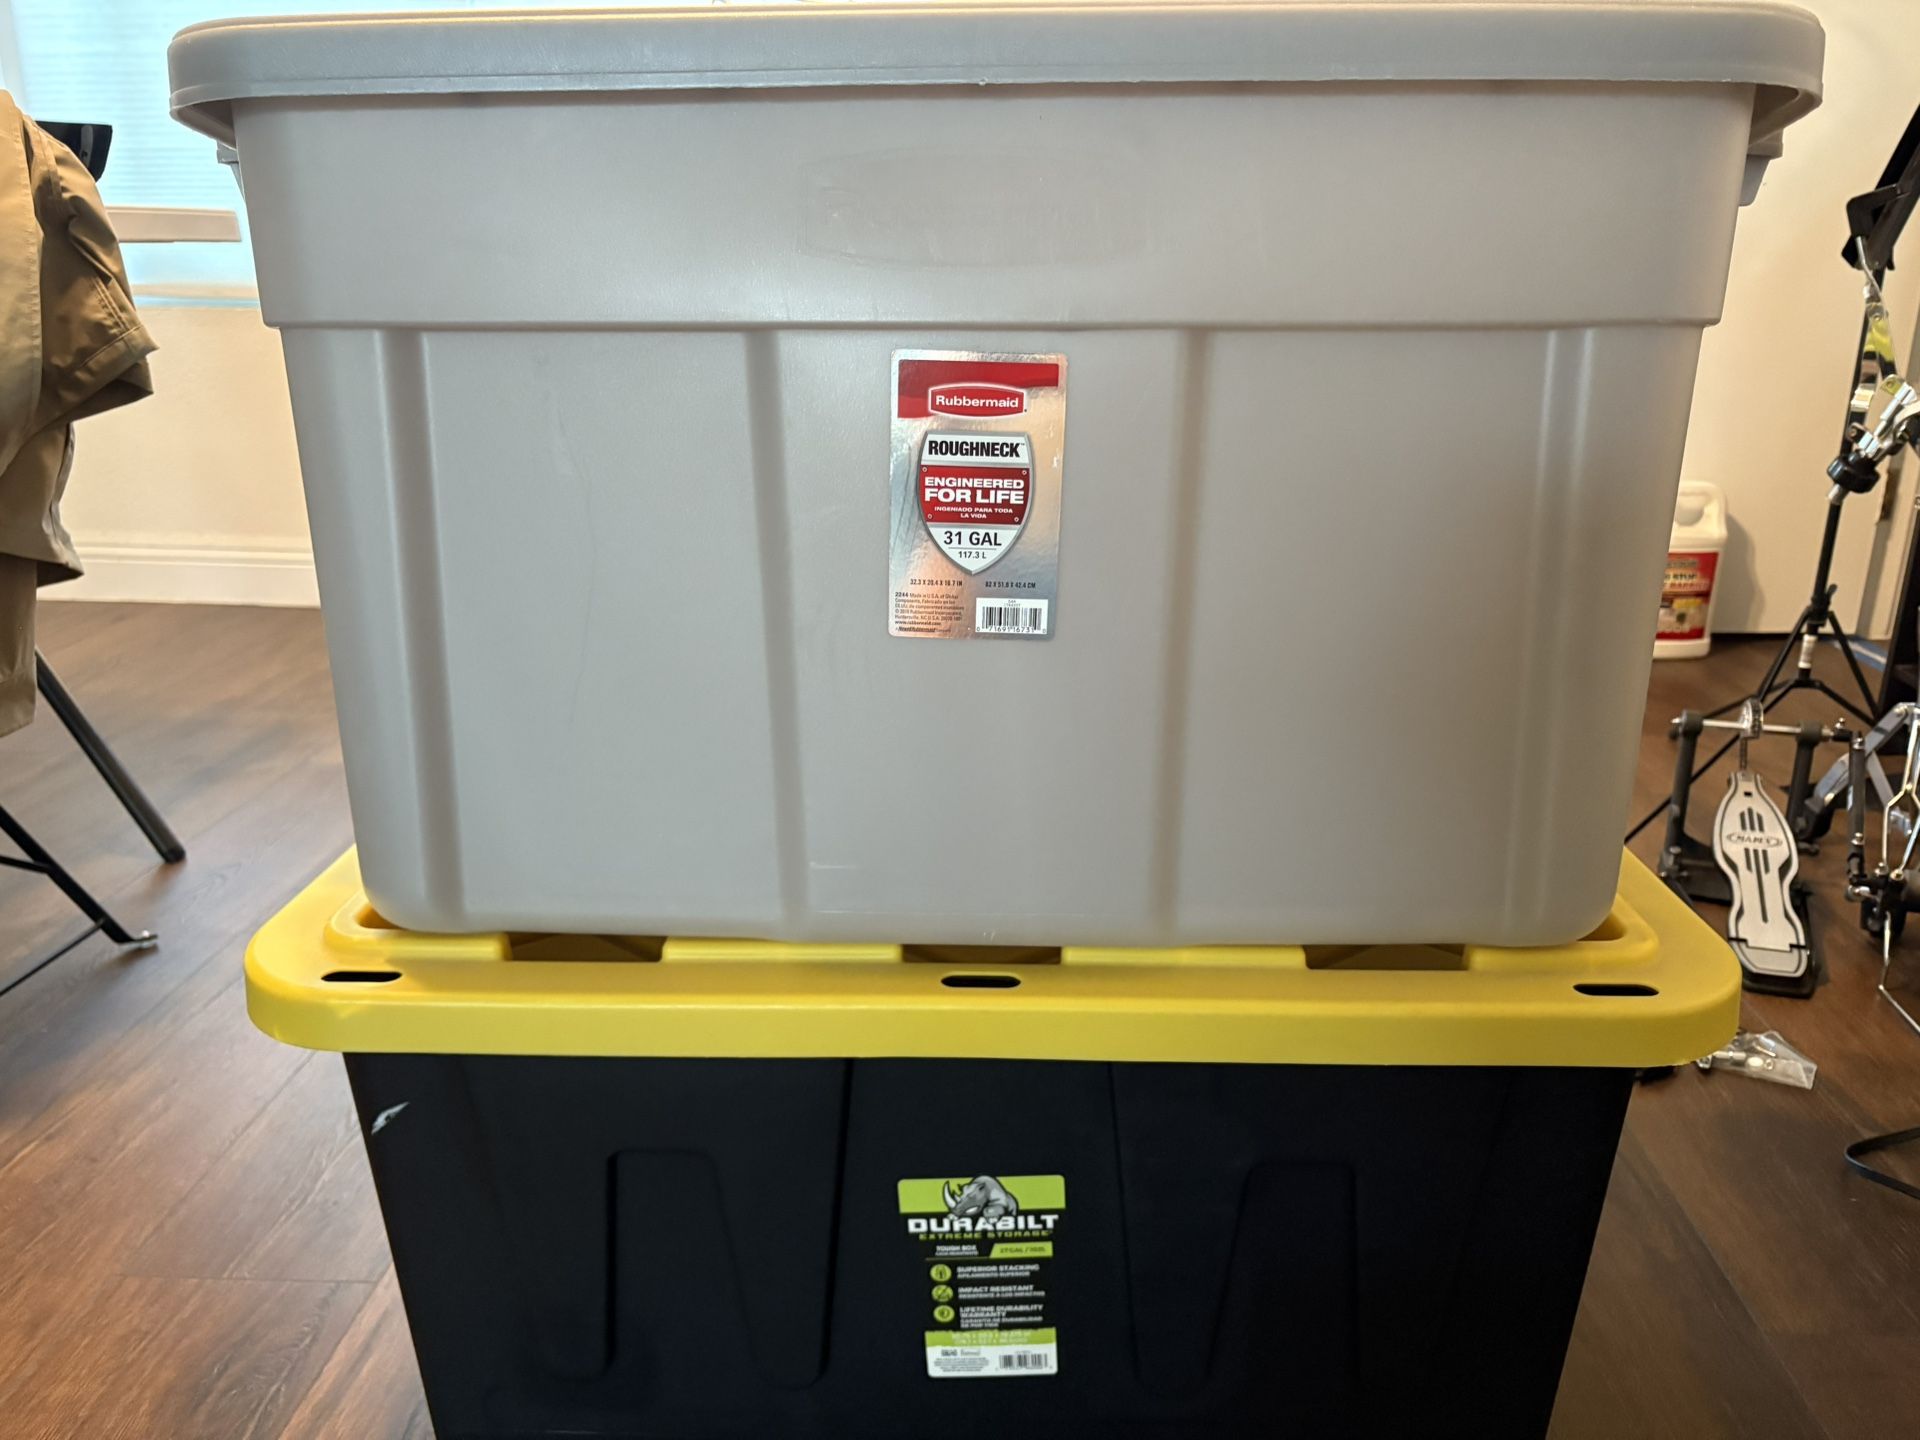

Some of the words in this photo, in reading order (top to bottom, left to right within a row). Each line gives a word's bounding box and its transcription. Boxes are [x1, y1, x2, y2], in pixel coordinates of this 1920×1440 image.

[936, 395, 1019, 408] Rubbermaid
[928, 440, 1020, 457] ROUGHNECK
[925, 476, 1024, 489] ENGINEERED
[925, 488, 971, 503] FOR
[975, 490, 1024, 504] LIFE
[943, 531, 963, 545] 31
[969, 531, 1002, 546] GAL
[958, 551, 980, 559] 117.3
[907, 1213, 1059, 1234] DURABILT
[919, 1231, 983, 1241] EXTREME
[986, 1230, 1051, 1239] STORAGE
[998, 1264, 1040, 1272] STACKING
[989, 1285, 1034, 1293] RESISTANT
